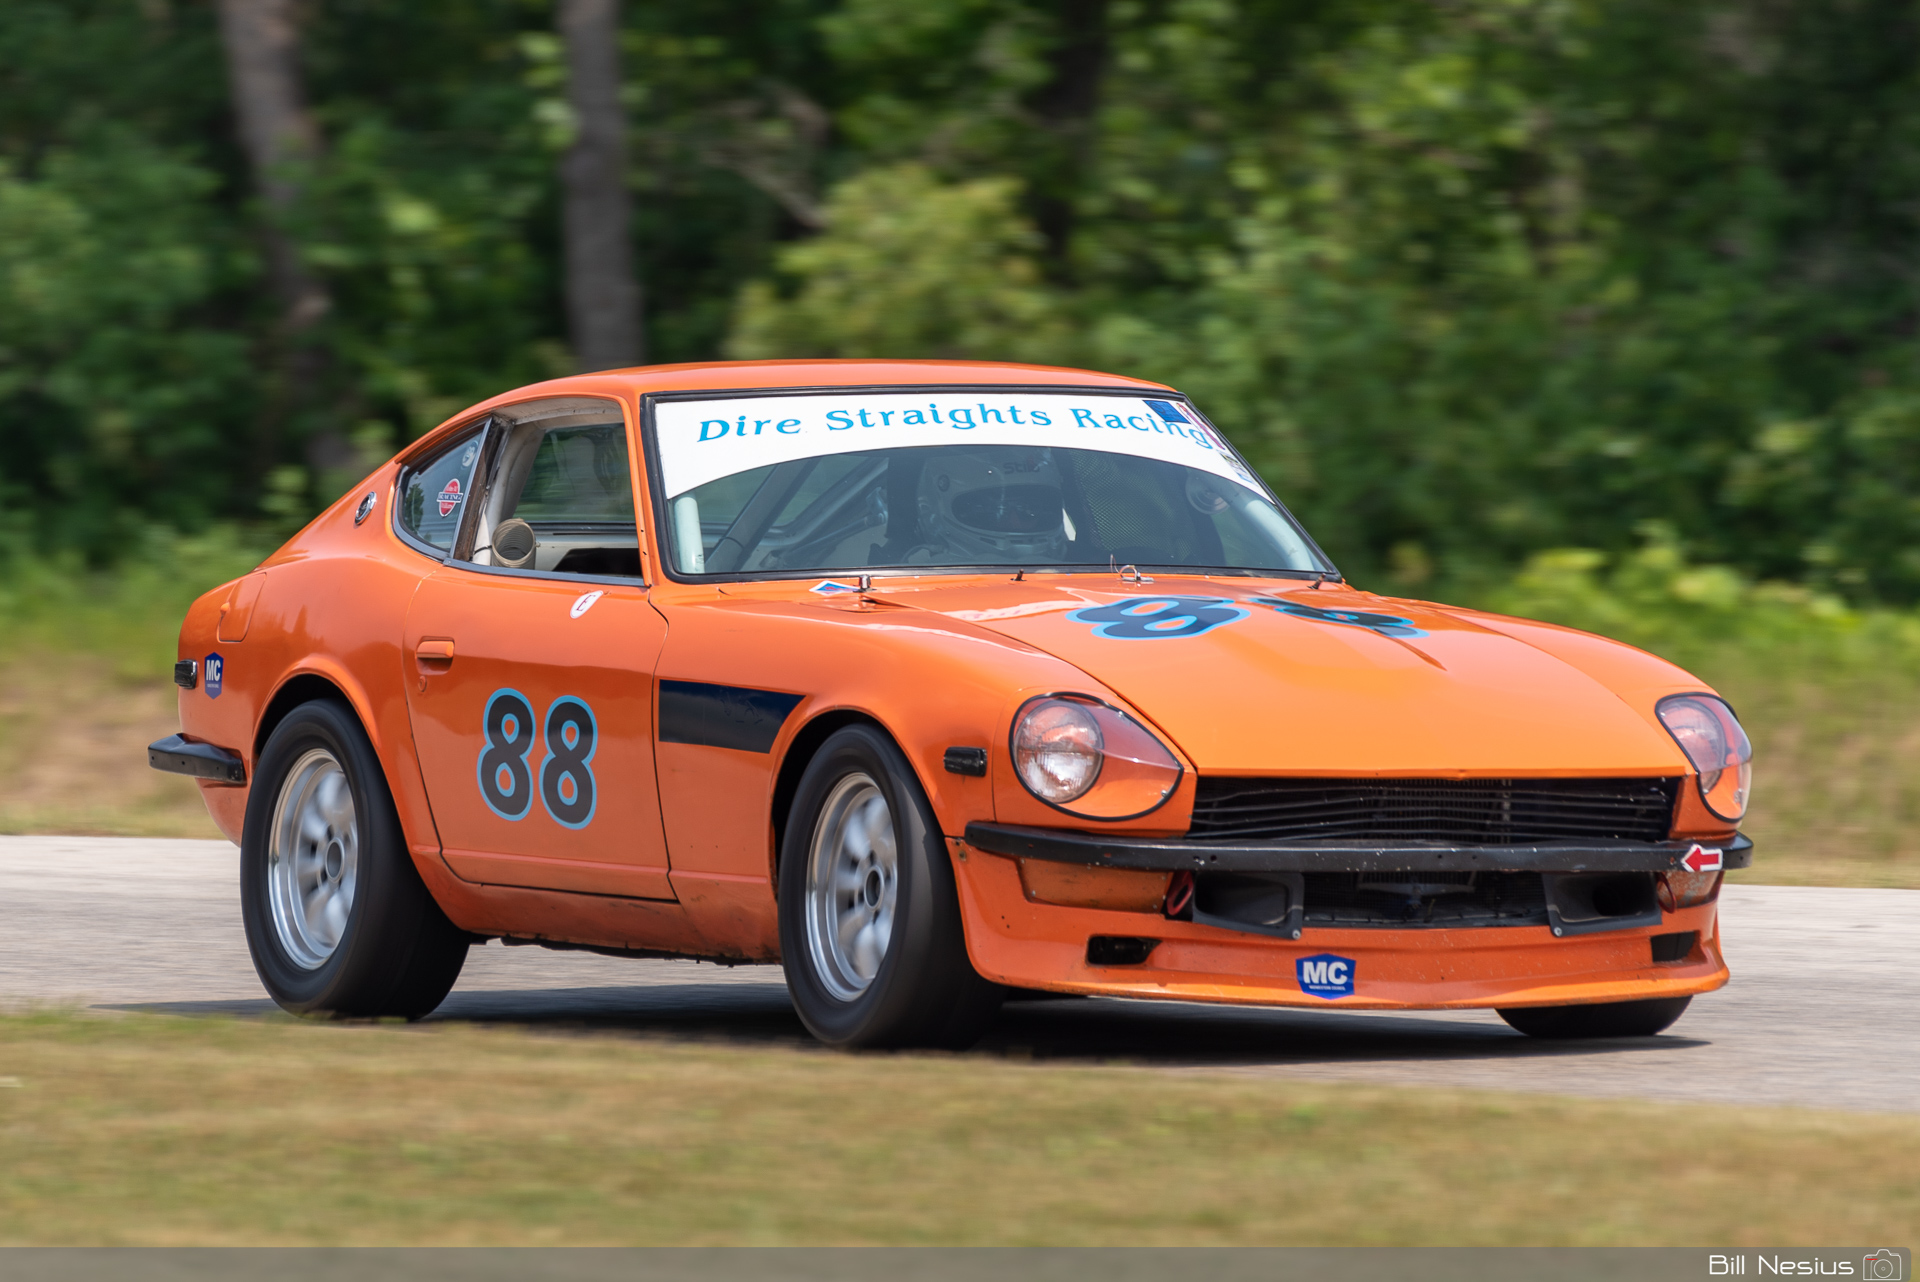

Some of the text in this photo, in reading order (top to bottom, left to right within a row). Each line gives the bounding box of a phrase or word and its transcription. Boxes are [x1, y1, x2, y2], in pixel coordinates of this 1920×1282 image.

[697, 403, 1214, 450] Dire Straights Racing
[206, 659, 221, 682] MC
[477, 687, 598, 830] 88
[1303, 961, 1348, 985] MC
